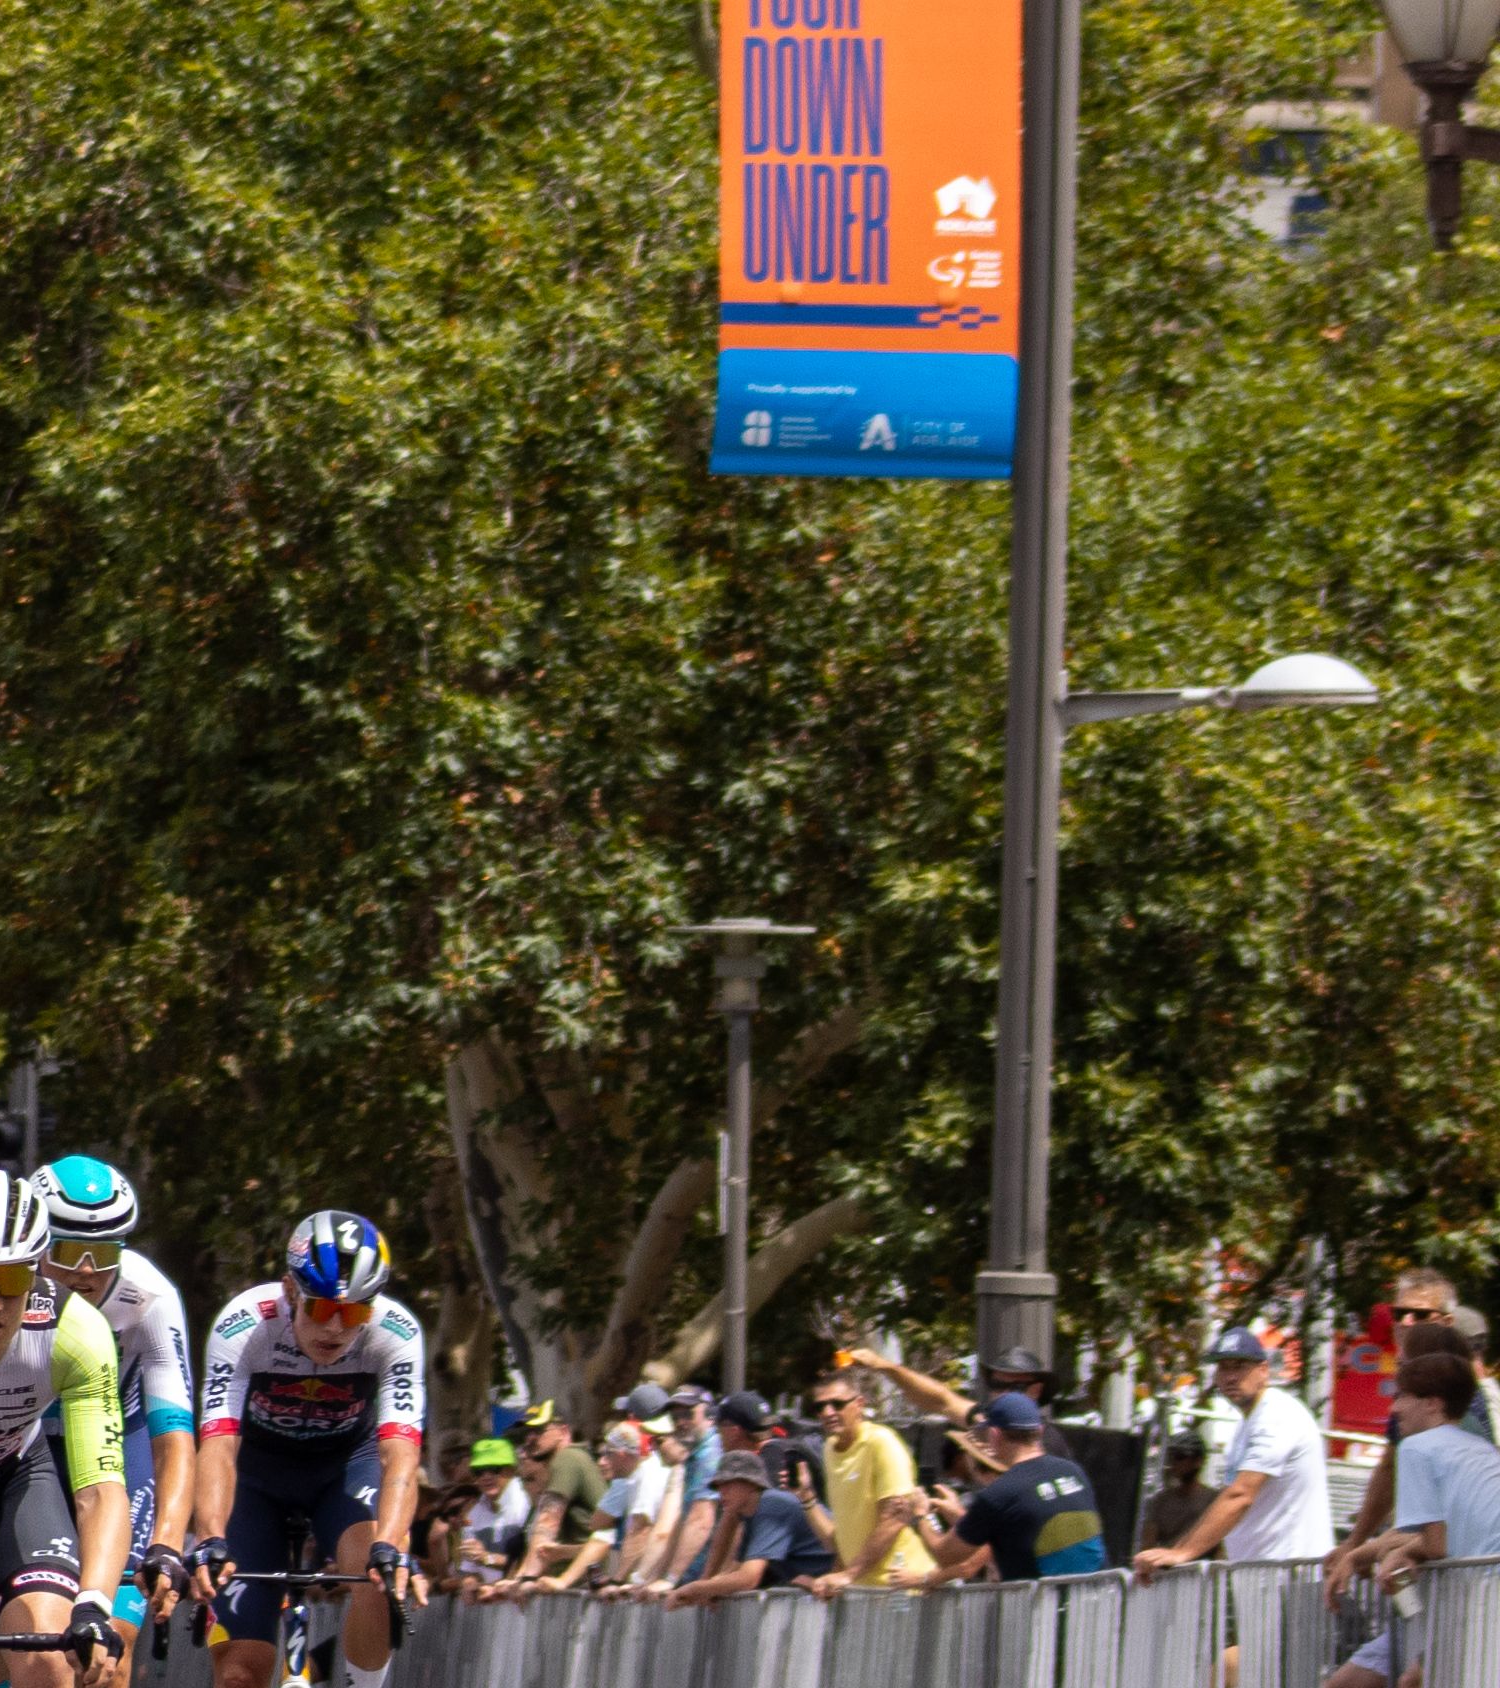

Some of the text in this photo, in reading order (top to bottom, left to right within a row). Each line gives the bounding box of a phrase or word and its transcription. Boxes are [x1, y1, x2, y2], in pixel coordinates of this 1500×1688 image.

[743, 37, 884, 157] DOWN
[743, 163, 889, 284] UNDER
[911, 433, 980, 447] ADELAIDE
[215, 1309, 251, 1333] BORA
[386, 1310, 418, 1335] BORA
[207, 1363, 233, 1409] BOSS
[393, 1361, 413, 1411] BOSS
